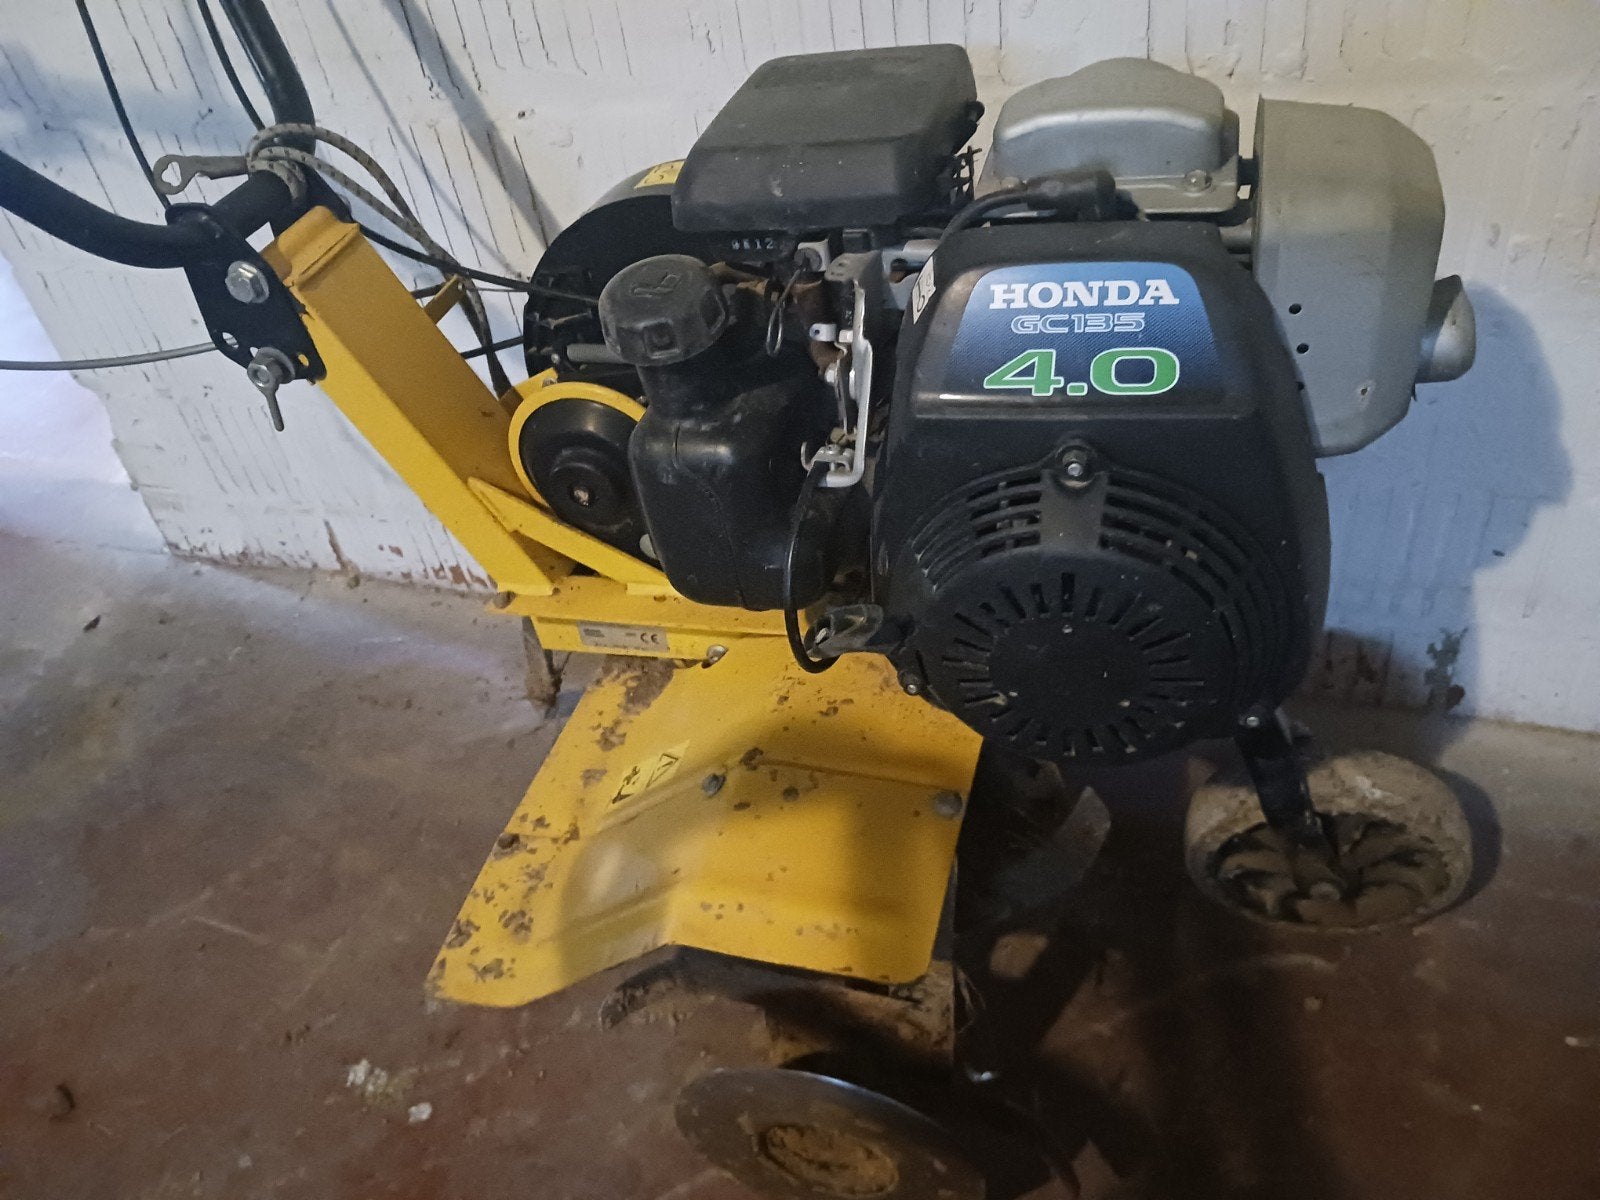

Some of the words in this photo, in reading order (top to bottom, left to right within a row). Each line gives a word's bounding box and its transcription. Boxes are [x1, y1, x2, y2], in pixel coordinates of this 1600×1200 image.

[989, 279, 1180, 310] HONDA
[1011, 312, 1146, 334] GC135
[983, 347, 1181, 397] 4.0
